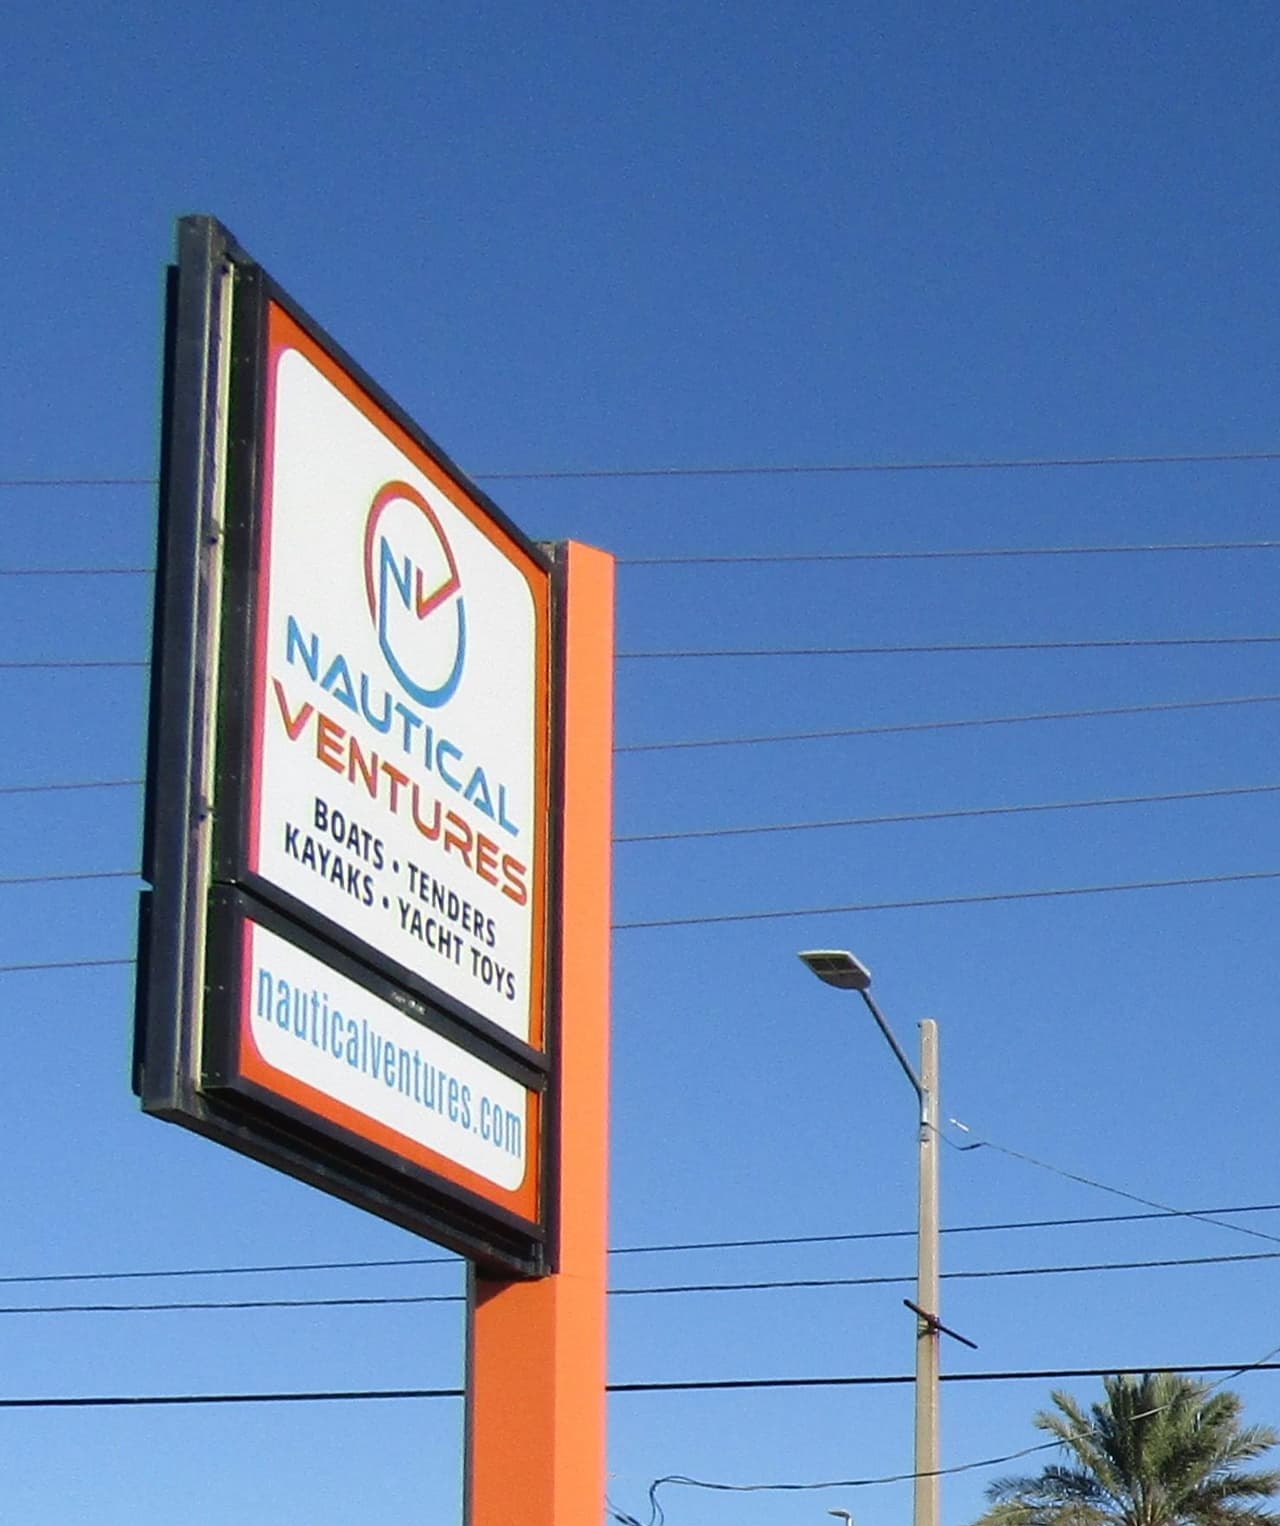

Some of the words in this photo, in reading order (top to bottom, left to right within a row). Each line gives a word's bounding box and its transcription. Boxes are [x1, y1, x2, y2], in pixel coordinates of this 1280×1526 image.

[272, 676, 527, 906] VENTURES
[286, 615, 519, 838] NAUTICAL
[284, 822, 374, 907] KAYAKS
[398, 896, 463, 966] YACHT
[470, 947, 516, 1001] TOYS
[314, 798, 384, 870] BOATS
[408, 862, 496, 948] TENDERS
[257, 968, 522, 1158] nauticalventures.com
